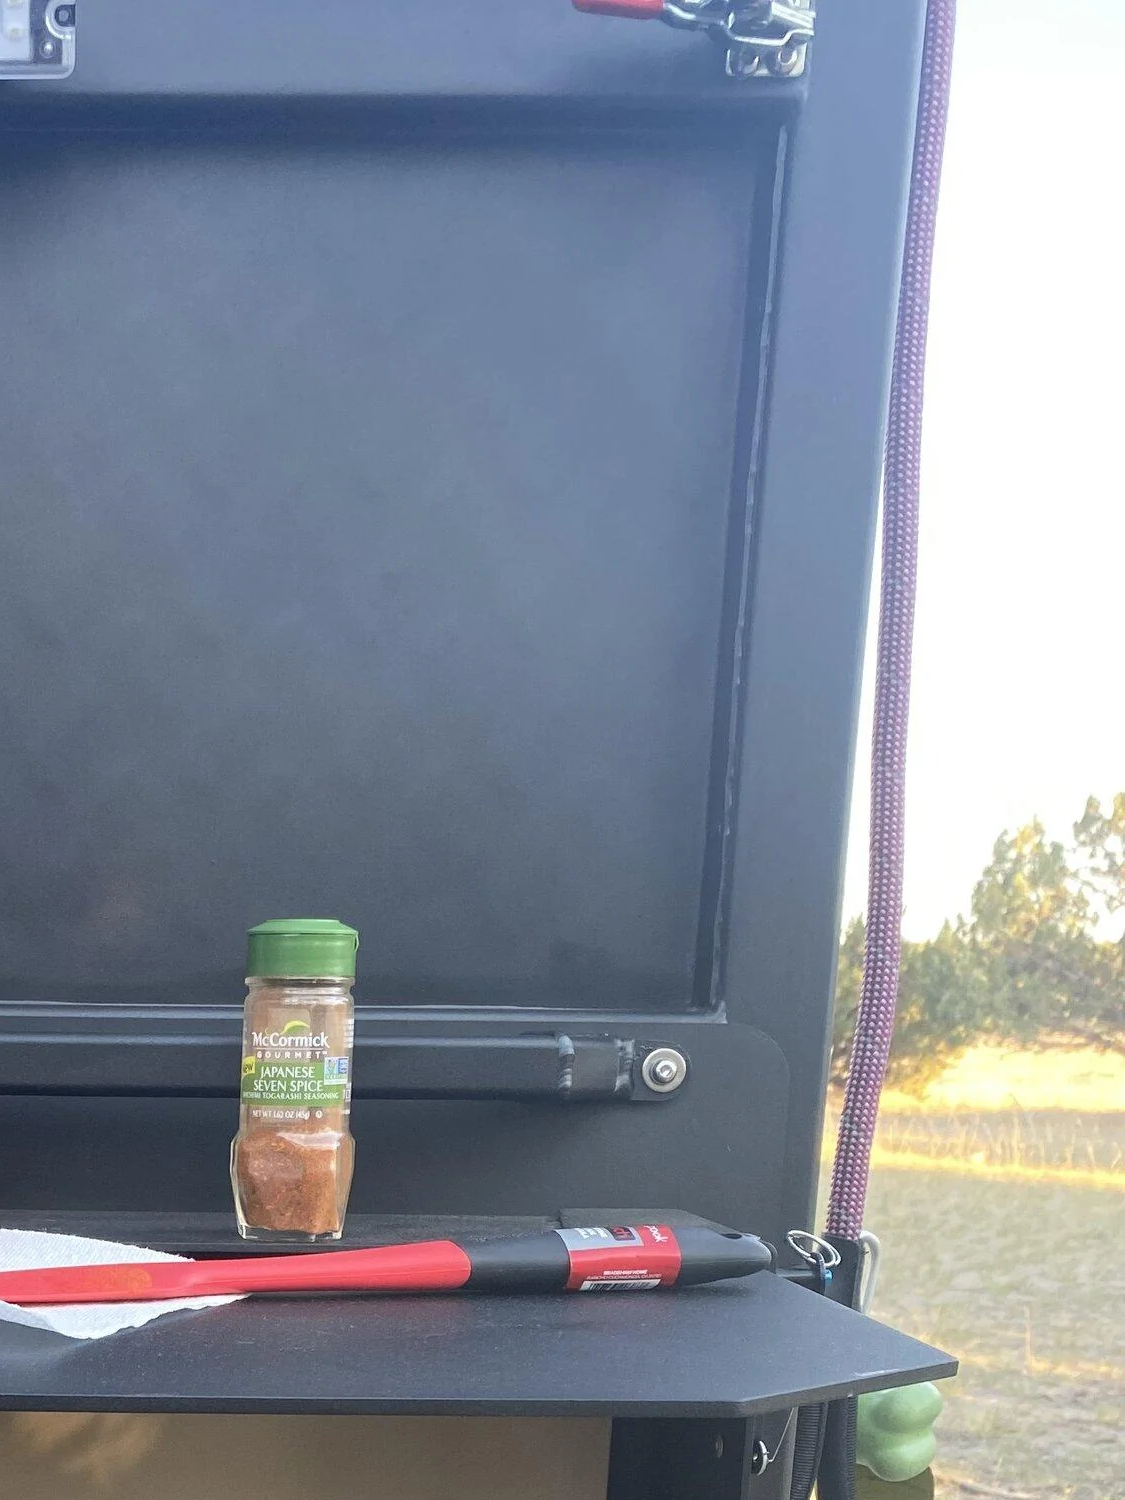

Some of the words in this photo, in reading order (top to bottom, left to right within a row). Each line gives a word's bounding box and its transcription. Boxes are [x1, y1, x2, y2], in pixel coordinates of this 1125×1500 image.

[252, 1031, 330, 1048] McCormick
[256, 1051, 323, 1059] GOURMET
[260, 1066, 315, 1079] JAPANESE
[253, 1080, 286, 1092] SEVEN
[289, 1080, 324, 1092] SPICE
[262, 1092, 302, 1100] TOGARASHI
[303, 1092, 340, 1100] SEASONING
